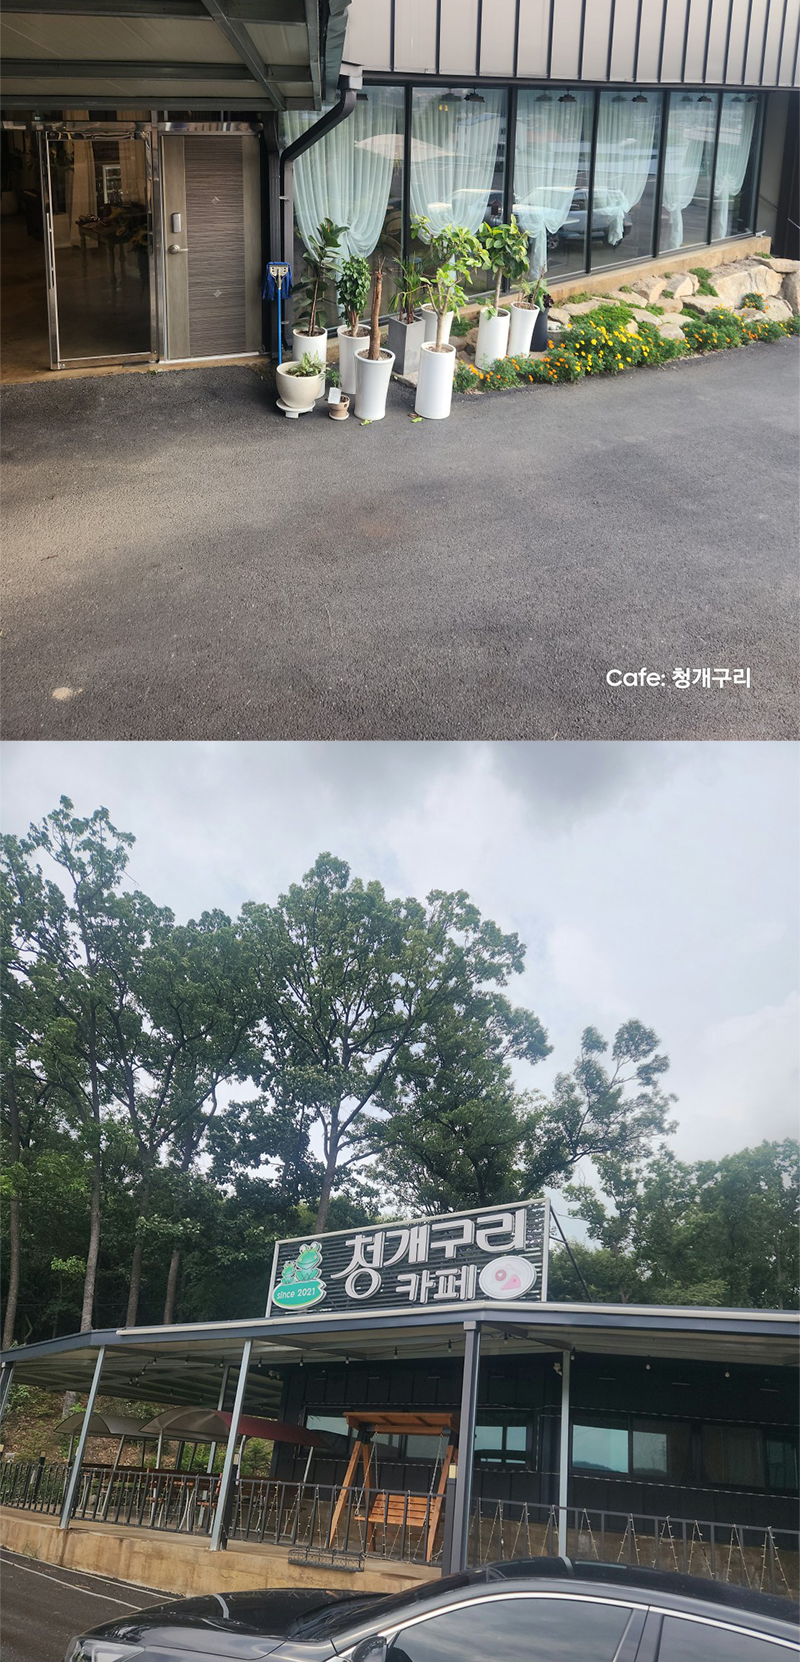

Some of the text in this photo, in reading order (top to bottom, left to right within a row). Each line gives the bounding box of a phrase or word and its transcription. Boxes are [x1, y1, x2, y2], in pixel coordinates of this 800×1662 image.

[330, 1208, 528, 1300] 청개구리
[276, 1287, 316, 1300] since 2021
[396, 1264, 477, 1304] 카페
